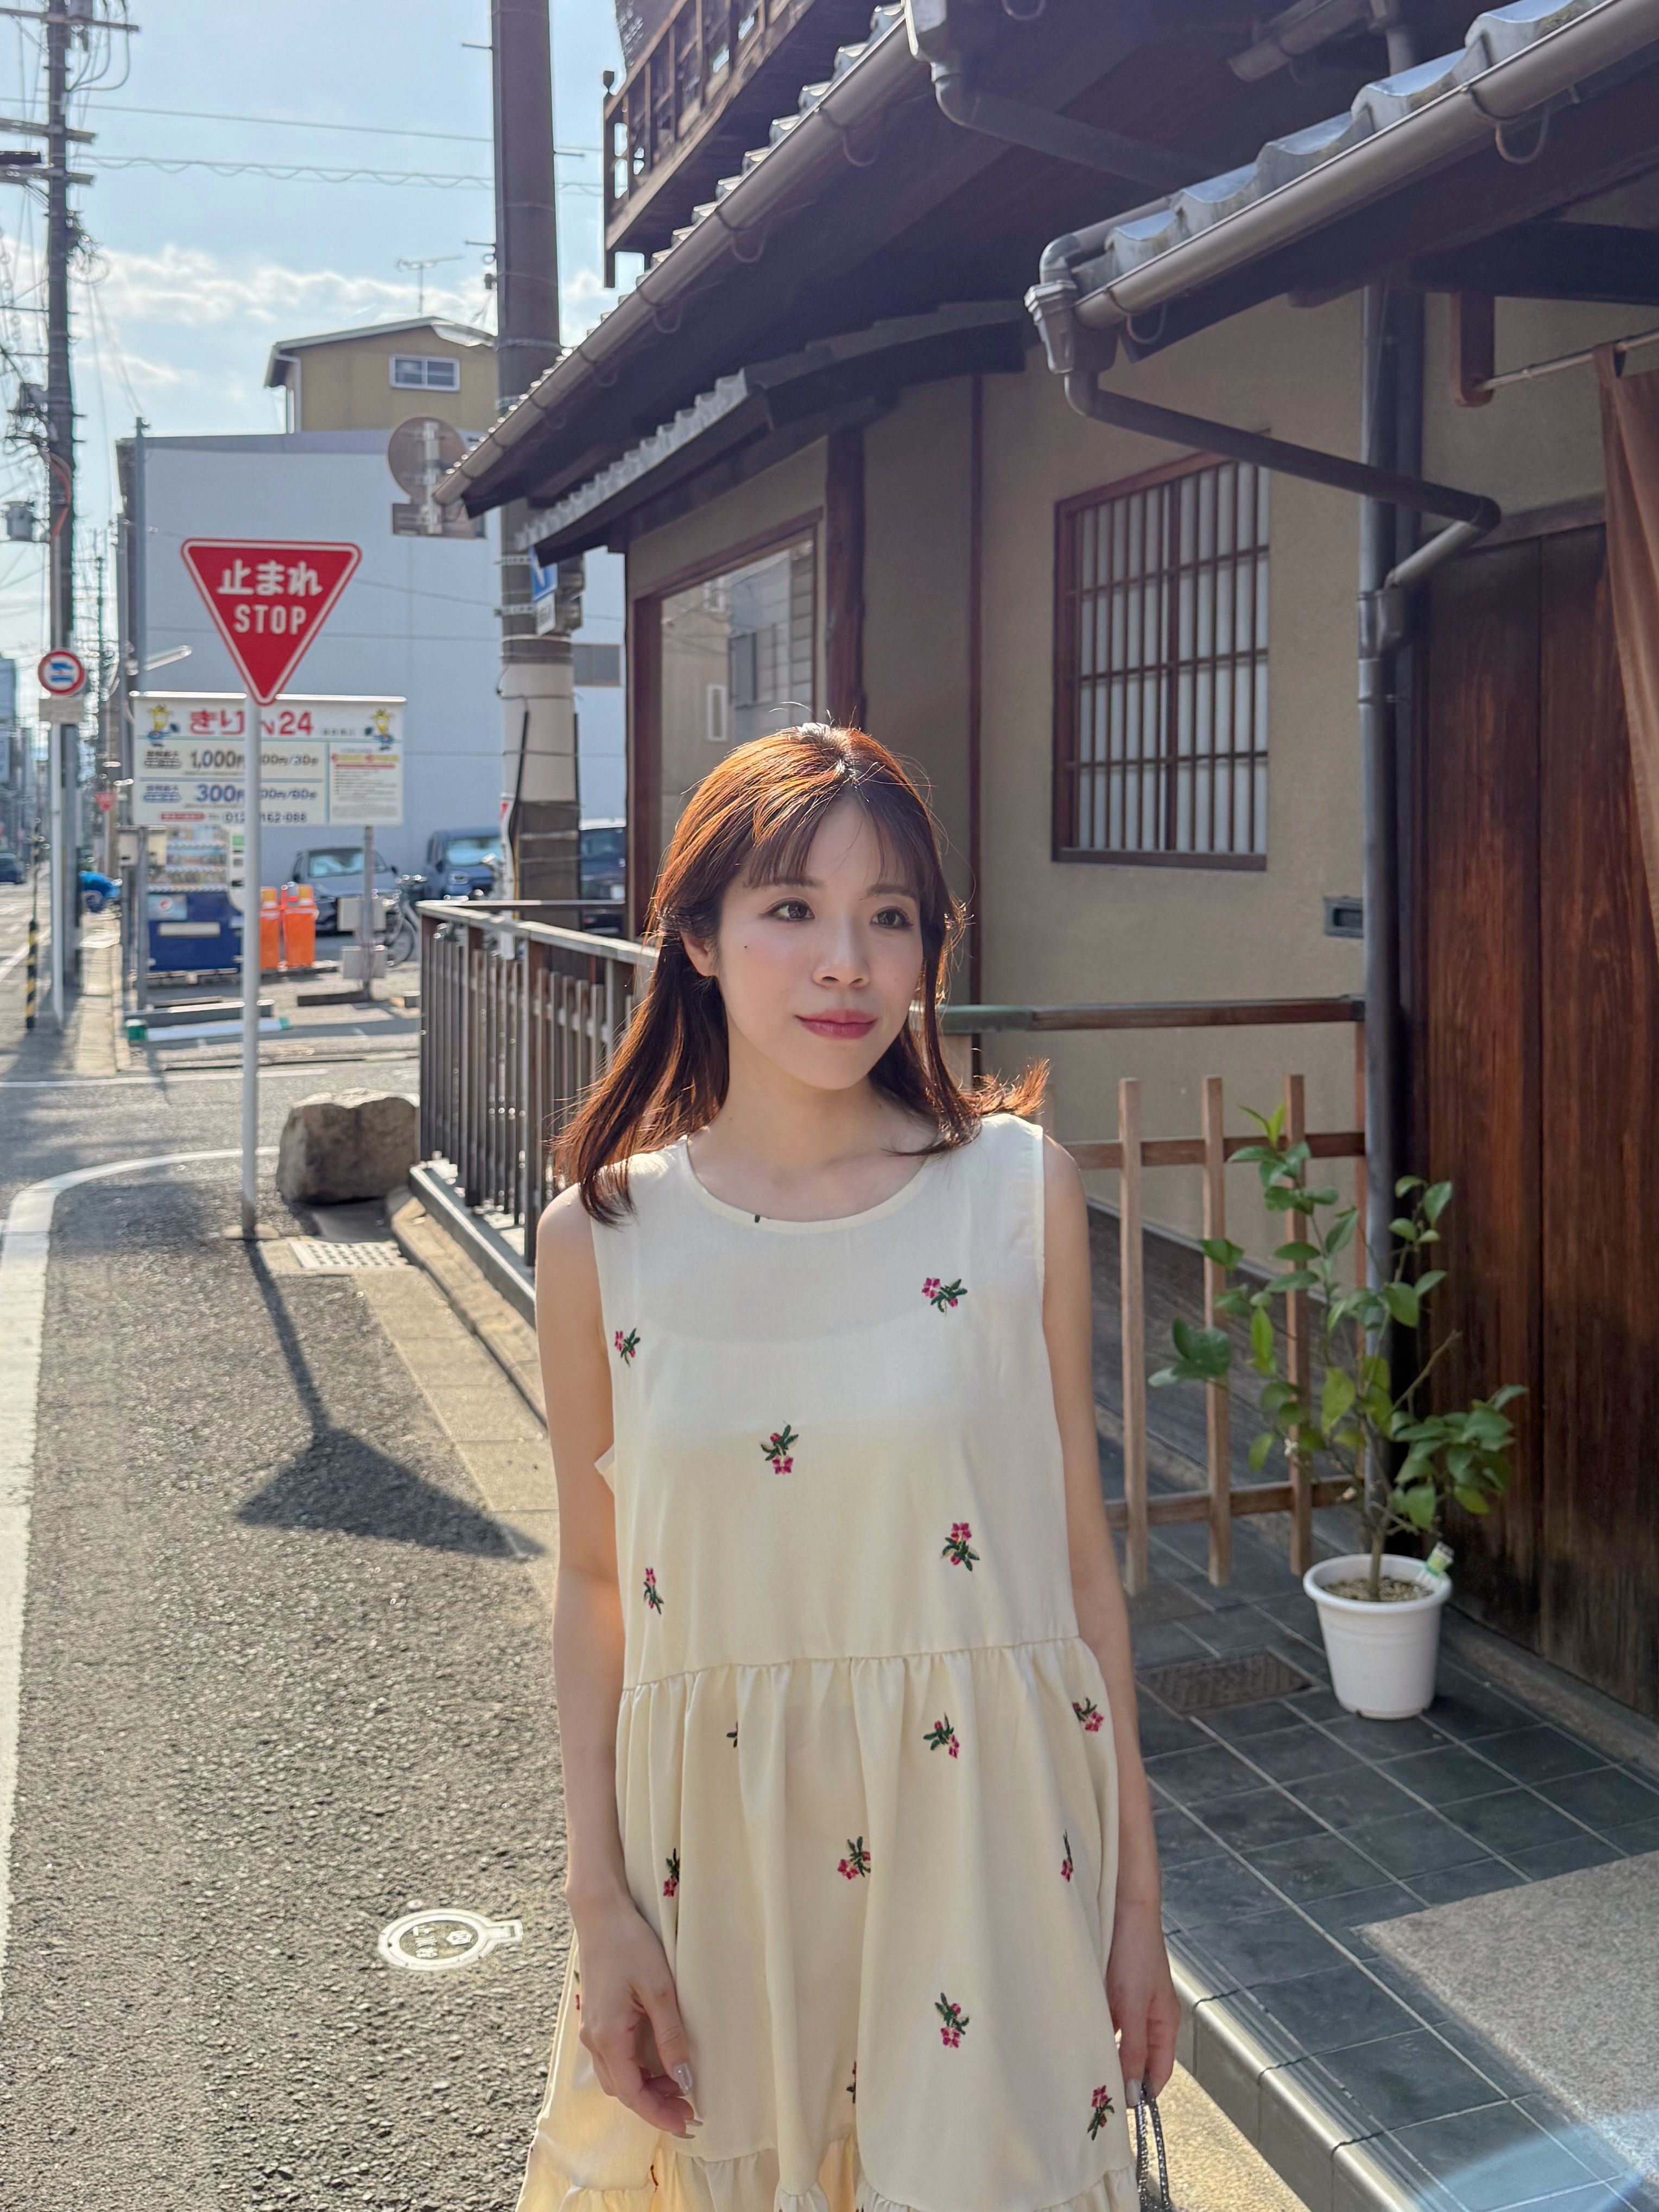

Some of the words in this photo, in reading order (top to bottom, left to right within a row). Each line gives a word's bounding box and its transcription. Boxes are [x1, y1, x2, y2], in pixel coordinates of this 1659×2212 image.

[217, 559, 323, 597] 止まれ
[233, 604, 306, 635] STOP
